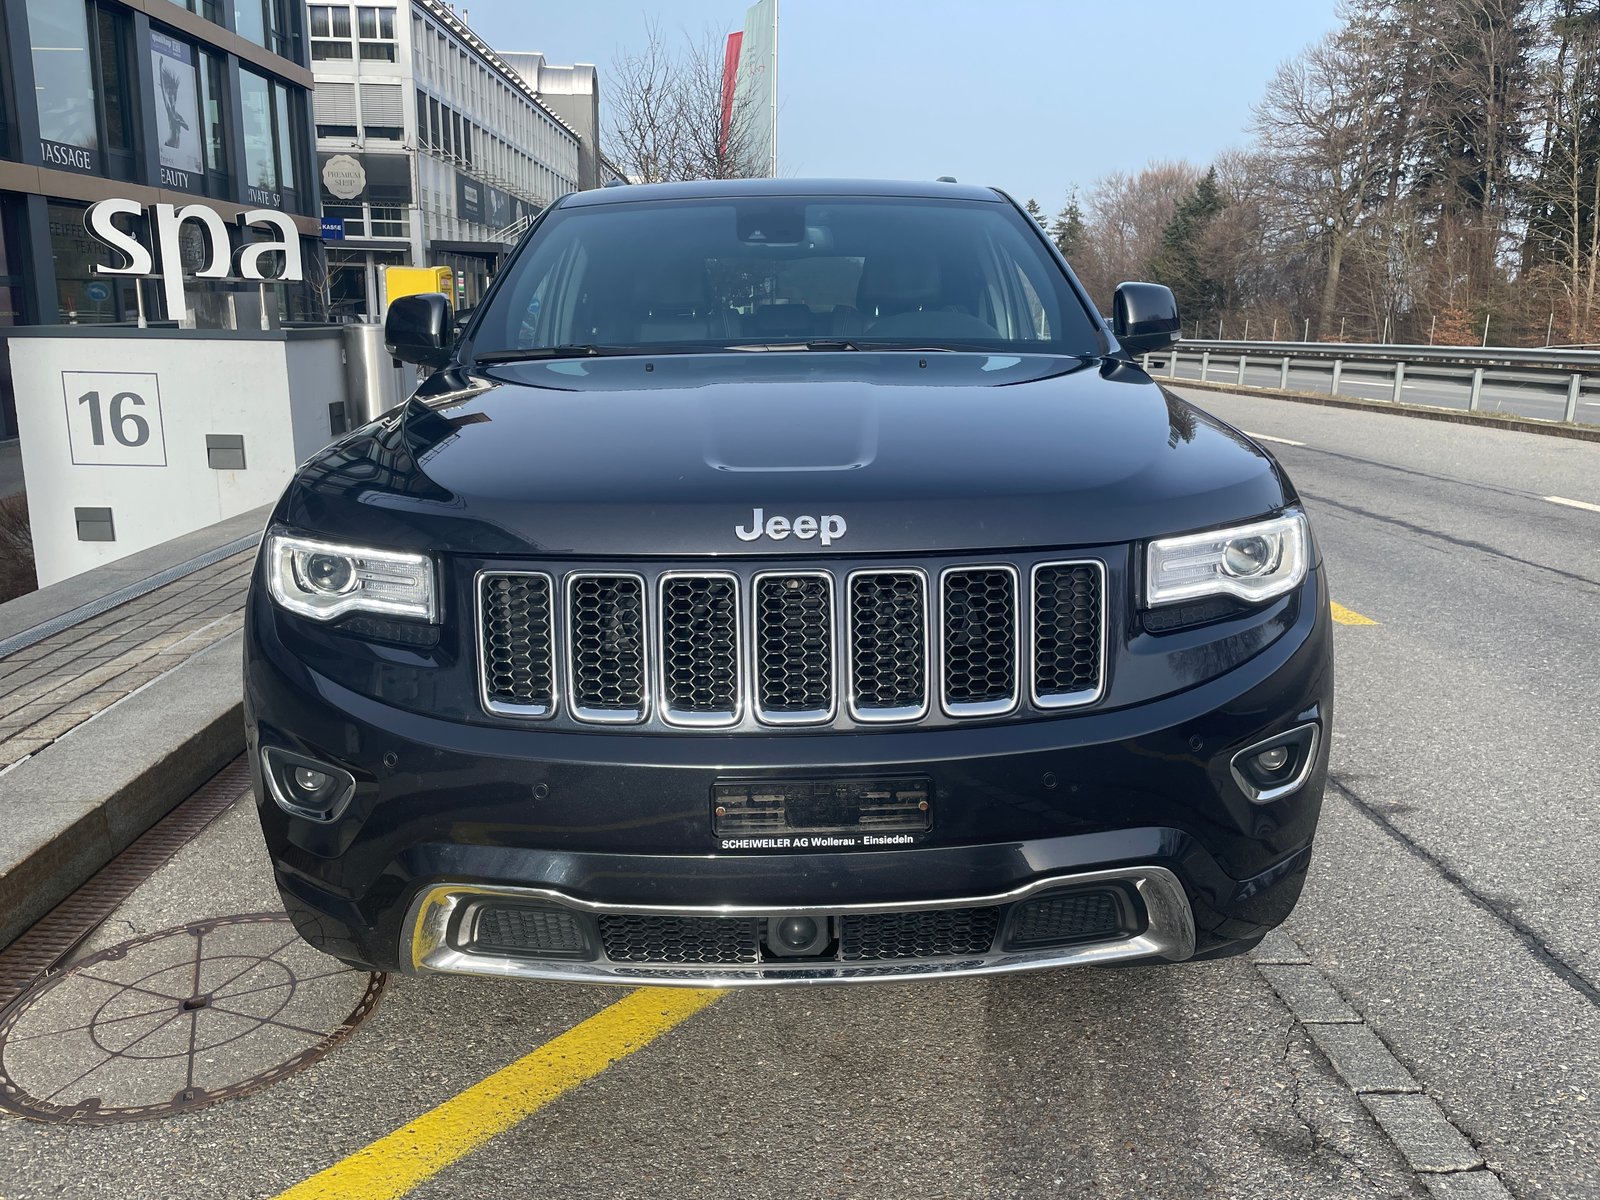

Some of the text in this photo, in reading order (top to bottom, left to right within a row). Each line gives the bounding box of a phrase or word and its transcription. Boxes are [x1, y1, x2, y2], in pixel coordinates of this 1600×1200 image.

[91, 199, 303, 321] spa
[78, 390, 150, 447] 16
[735, 508, 847, 546] Jeep
[721, 838, 791, 849] SCHEIWEILER
[793, 837, 809, 847] AG
[811, 836, 855, 847] Wollerau
[863, 834, 914, 845] Einsiedeln
